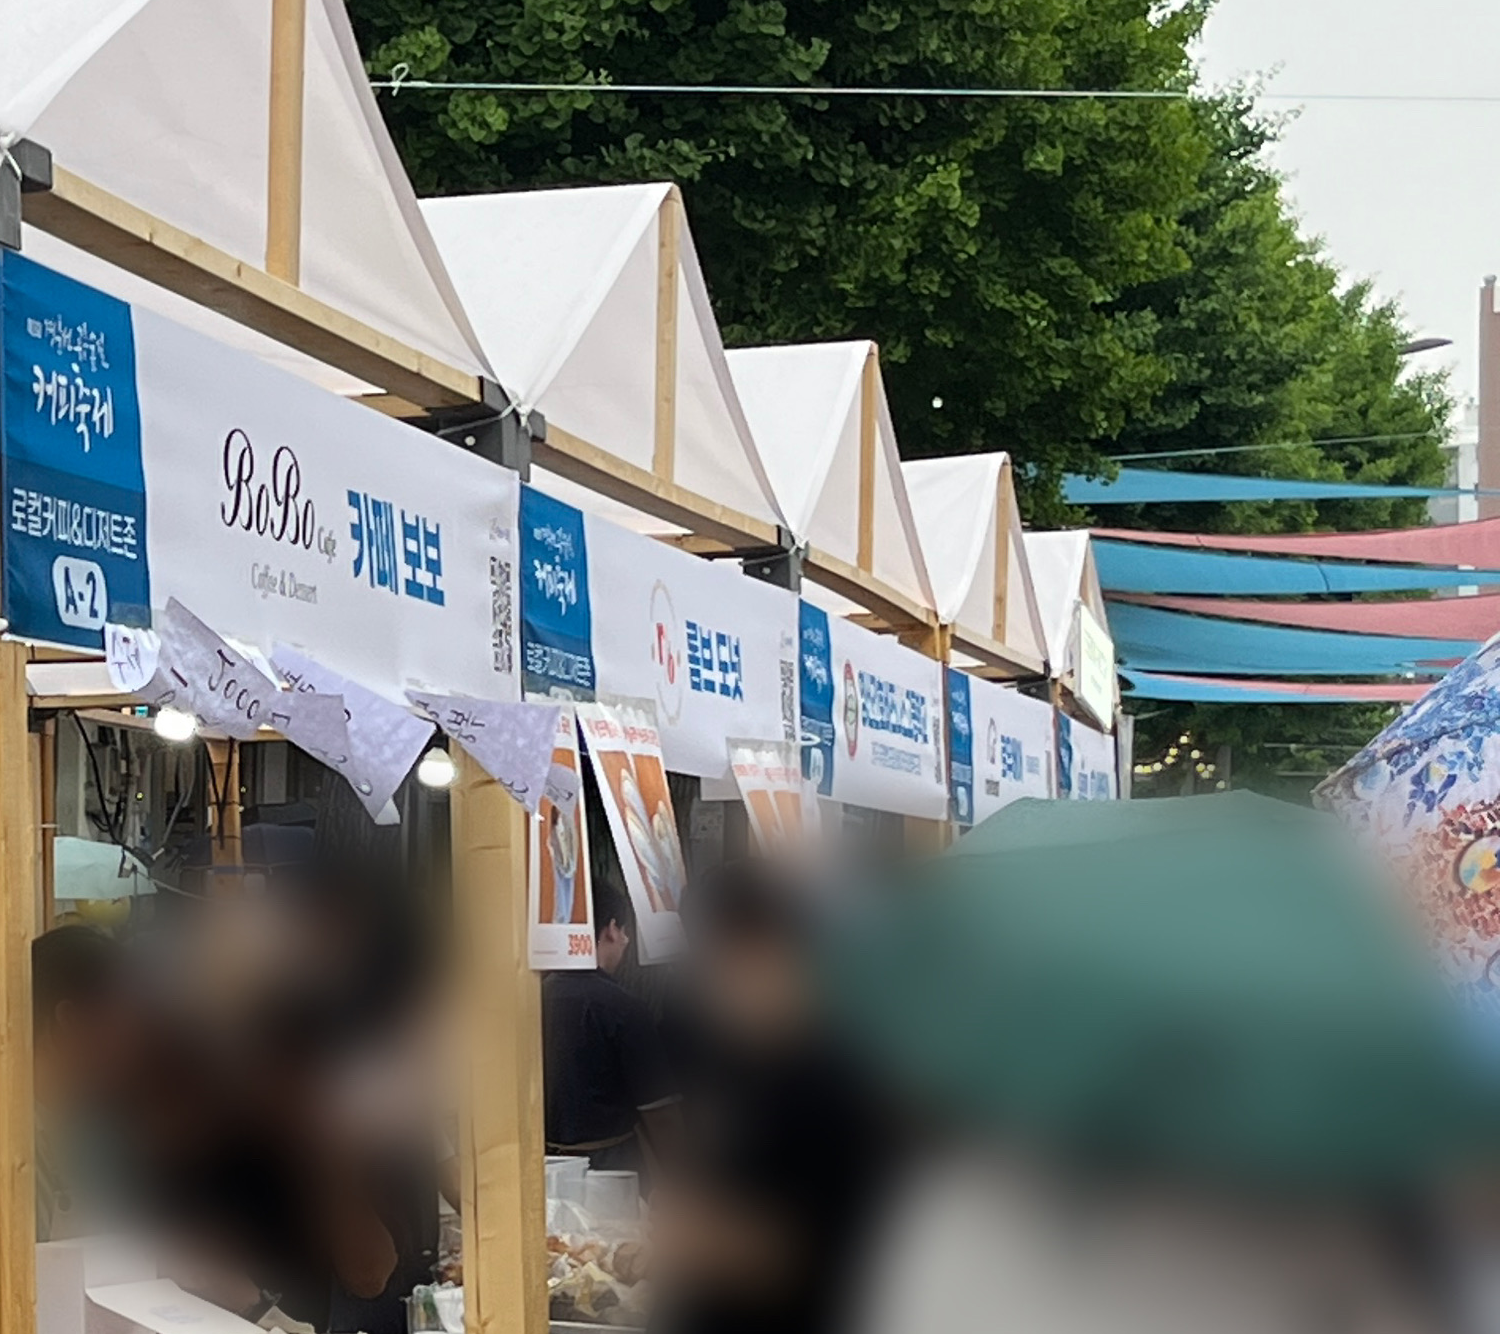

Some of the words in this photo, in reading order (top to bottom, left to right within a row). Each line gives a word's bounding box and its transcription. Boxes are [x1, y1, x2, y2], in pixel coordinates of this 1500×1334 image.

[32, 363, 115, 454] 커피축제
[220, 428, 316, 551] BoBo
[62, 566, 99, 618] A-2
